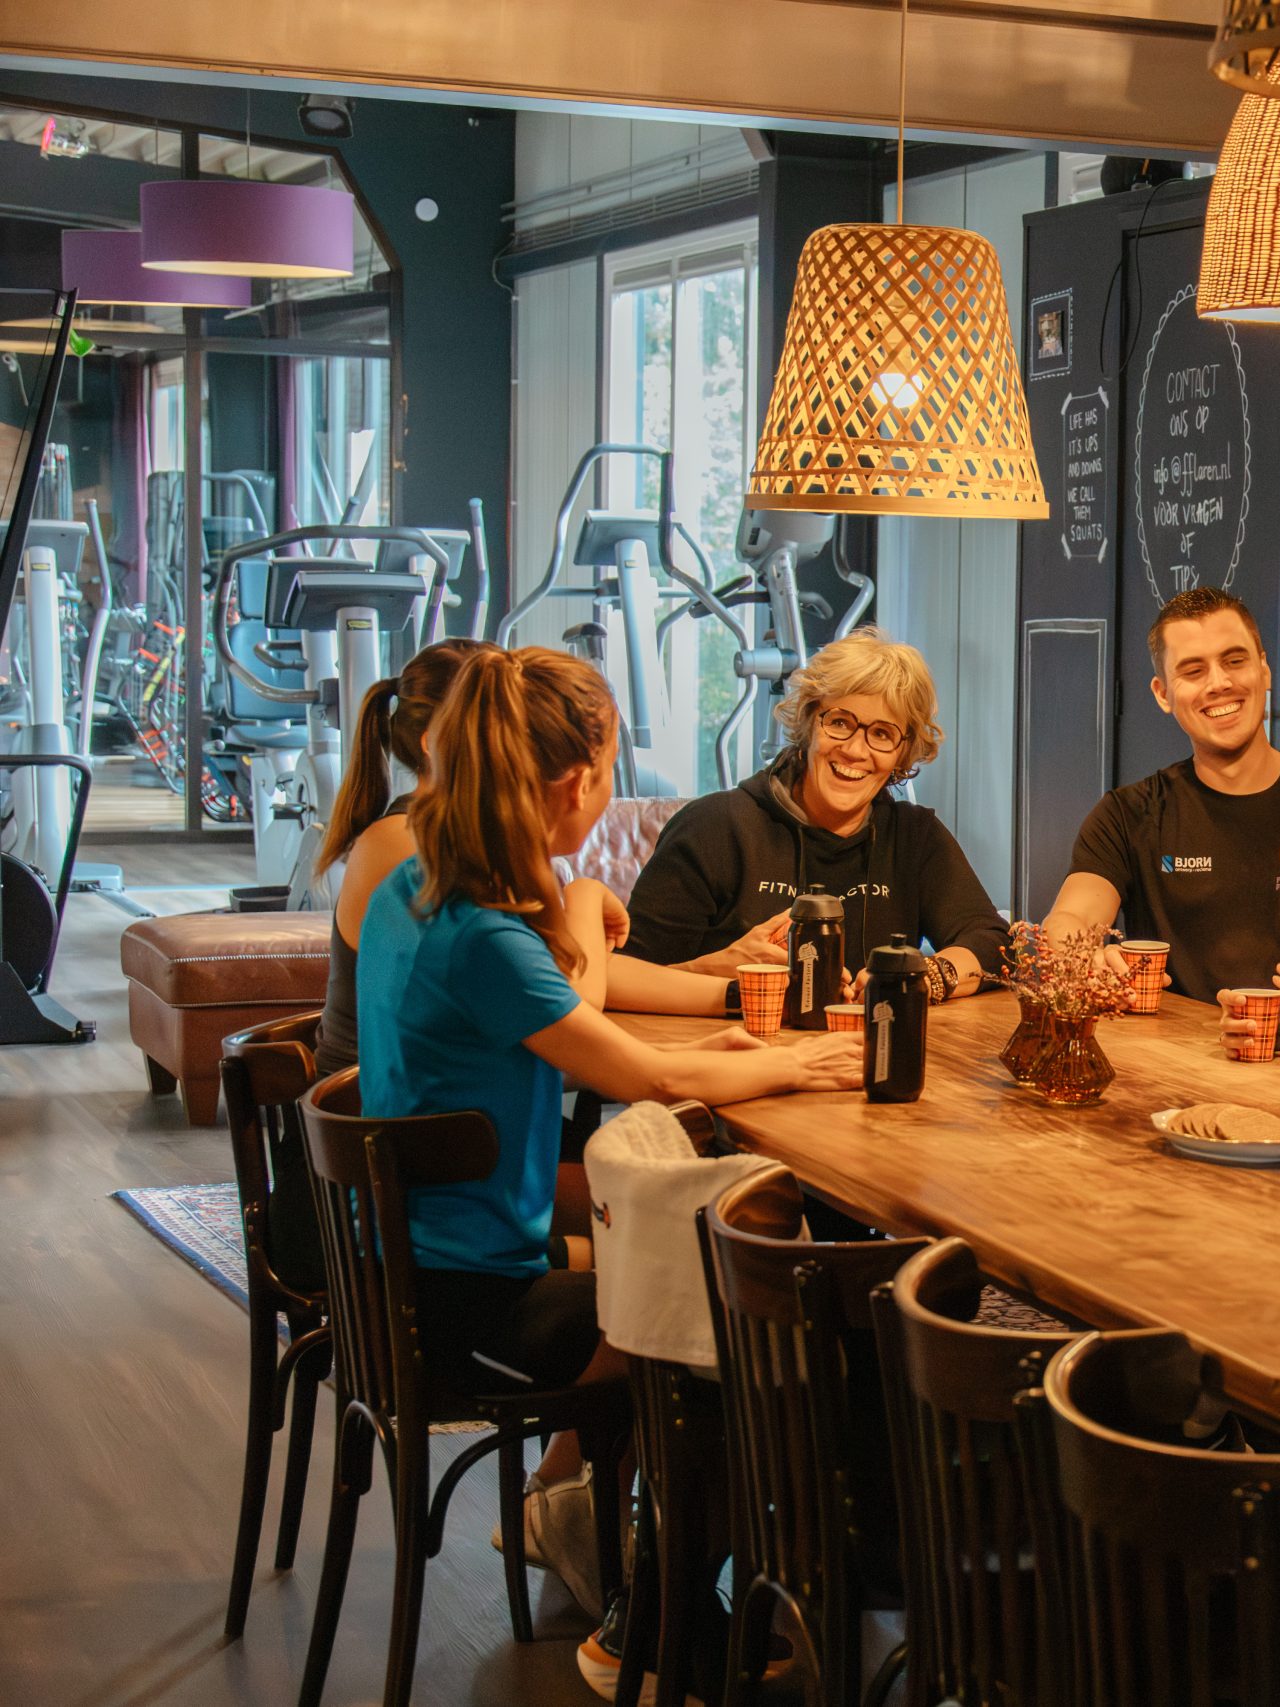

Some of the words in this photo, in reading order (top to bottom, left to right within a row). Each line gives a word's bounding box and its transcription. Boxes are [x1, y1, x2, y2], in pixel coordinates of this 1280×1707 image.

[1166, 364, 1221, 403] CONTACT
[1069, 411, 1083, 431] LIFE
[1085, 408, 1098, 427] HAS
[1169, 409, 1188, 438] ONS
[1195, 405, 1209, 433] OP
[1085, 433, 1098, 452] UPS
[1067, 462, 1080, 478] AND
[1067, 487, 1078, 503] WE
[1080, 486, 1096, 502] CALL
[1073, 505, 1091, 520] THEM
[1183, 497, 1223, 527] VRAGEN
[1070, 523, 1103, 542] SQUATS
[1180, 531, 1196, 559] OF
[1169, 565, 1200, 592] TIPS
[758, 881, 798, 898] FITN
